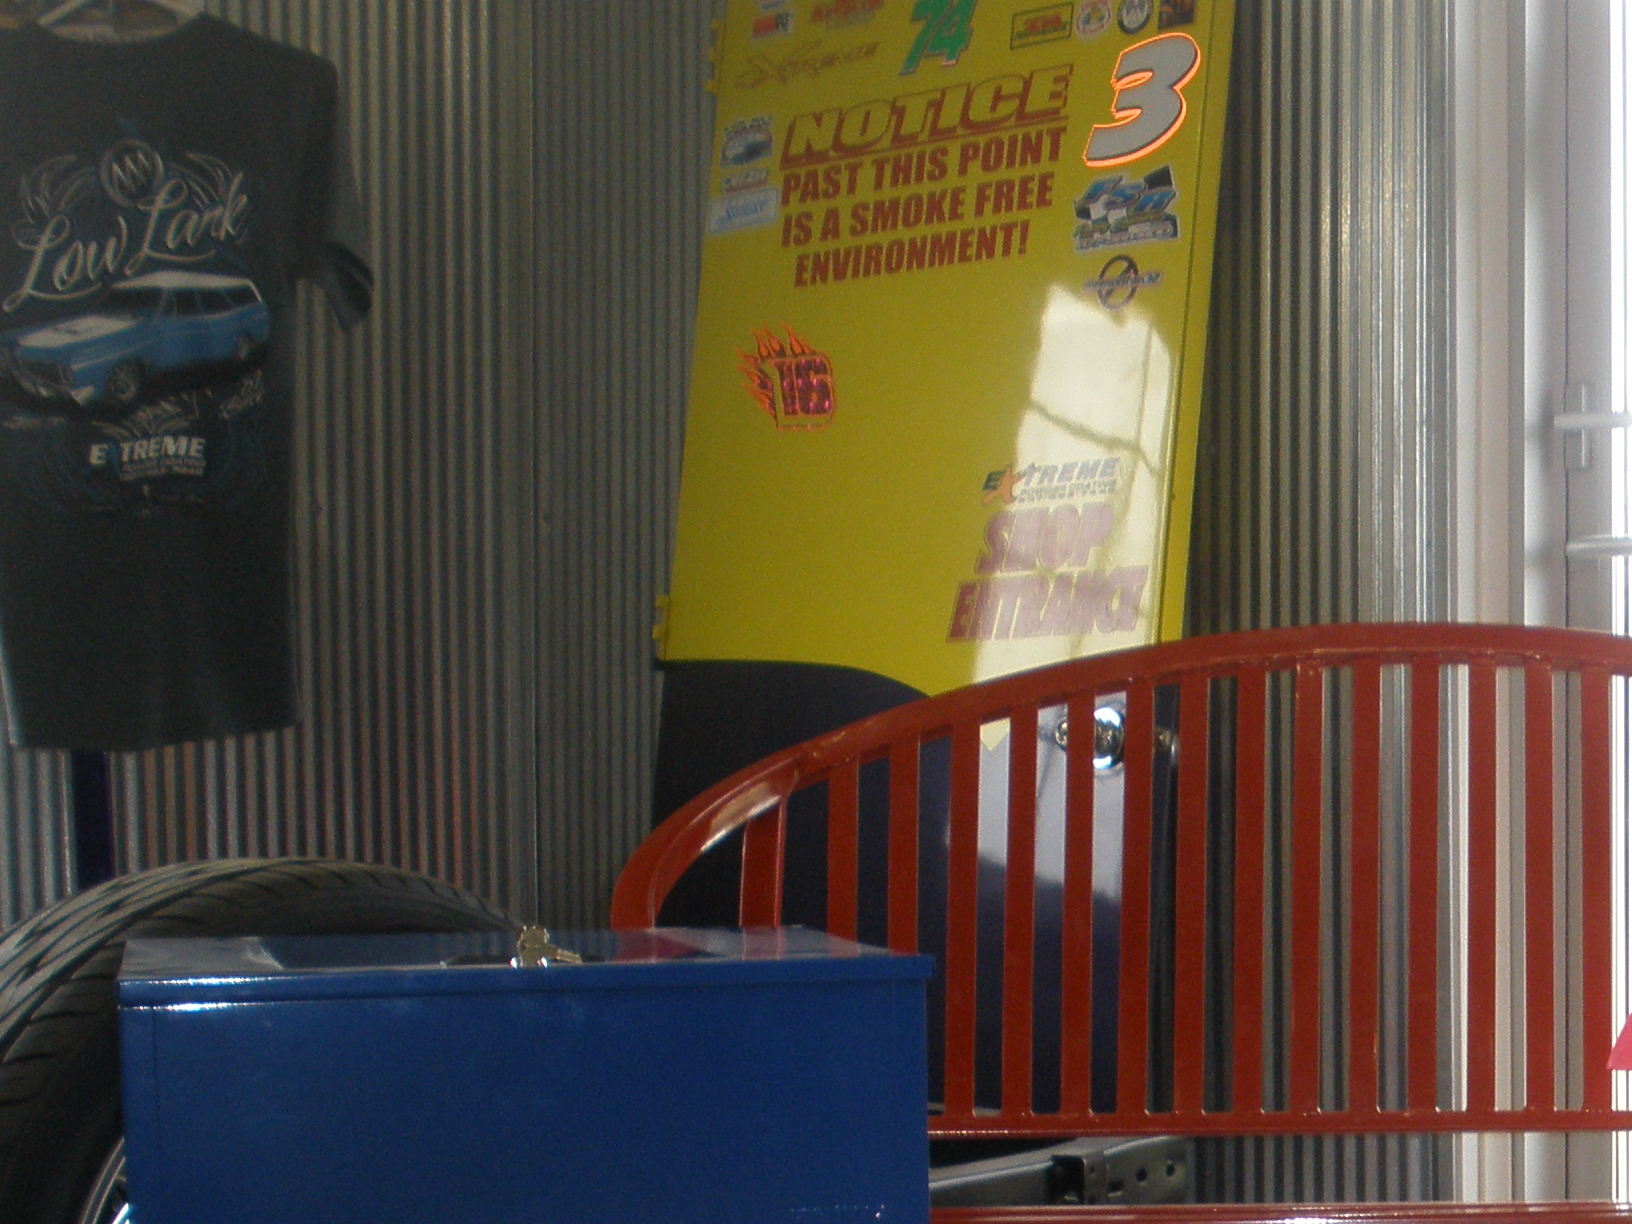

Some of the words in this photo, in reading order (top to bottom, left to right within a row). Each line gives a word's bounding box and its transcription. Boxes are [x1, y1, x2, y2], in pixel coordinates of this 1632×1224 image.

[780, 63, 1074, 172] NOTICE
[1082, 32, 1200, 168] 3
[781, 159, 867, 206] PAST
[871, 145, 949, 192] THIS
[957, 126, 1069, 178] POINT
[781, 211, 815, 248] IS
[819, 209, 841, 241] A
[849, 187, 966, 235] SMOKE
[973, 171, 1056, 217] FREE
[794, 219, 1031, 288] ENVIRONMENT!
[974, 501, 1114, 574] SHOP
[946, 565, 1148, 641] ENTRANCE
